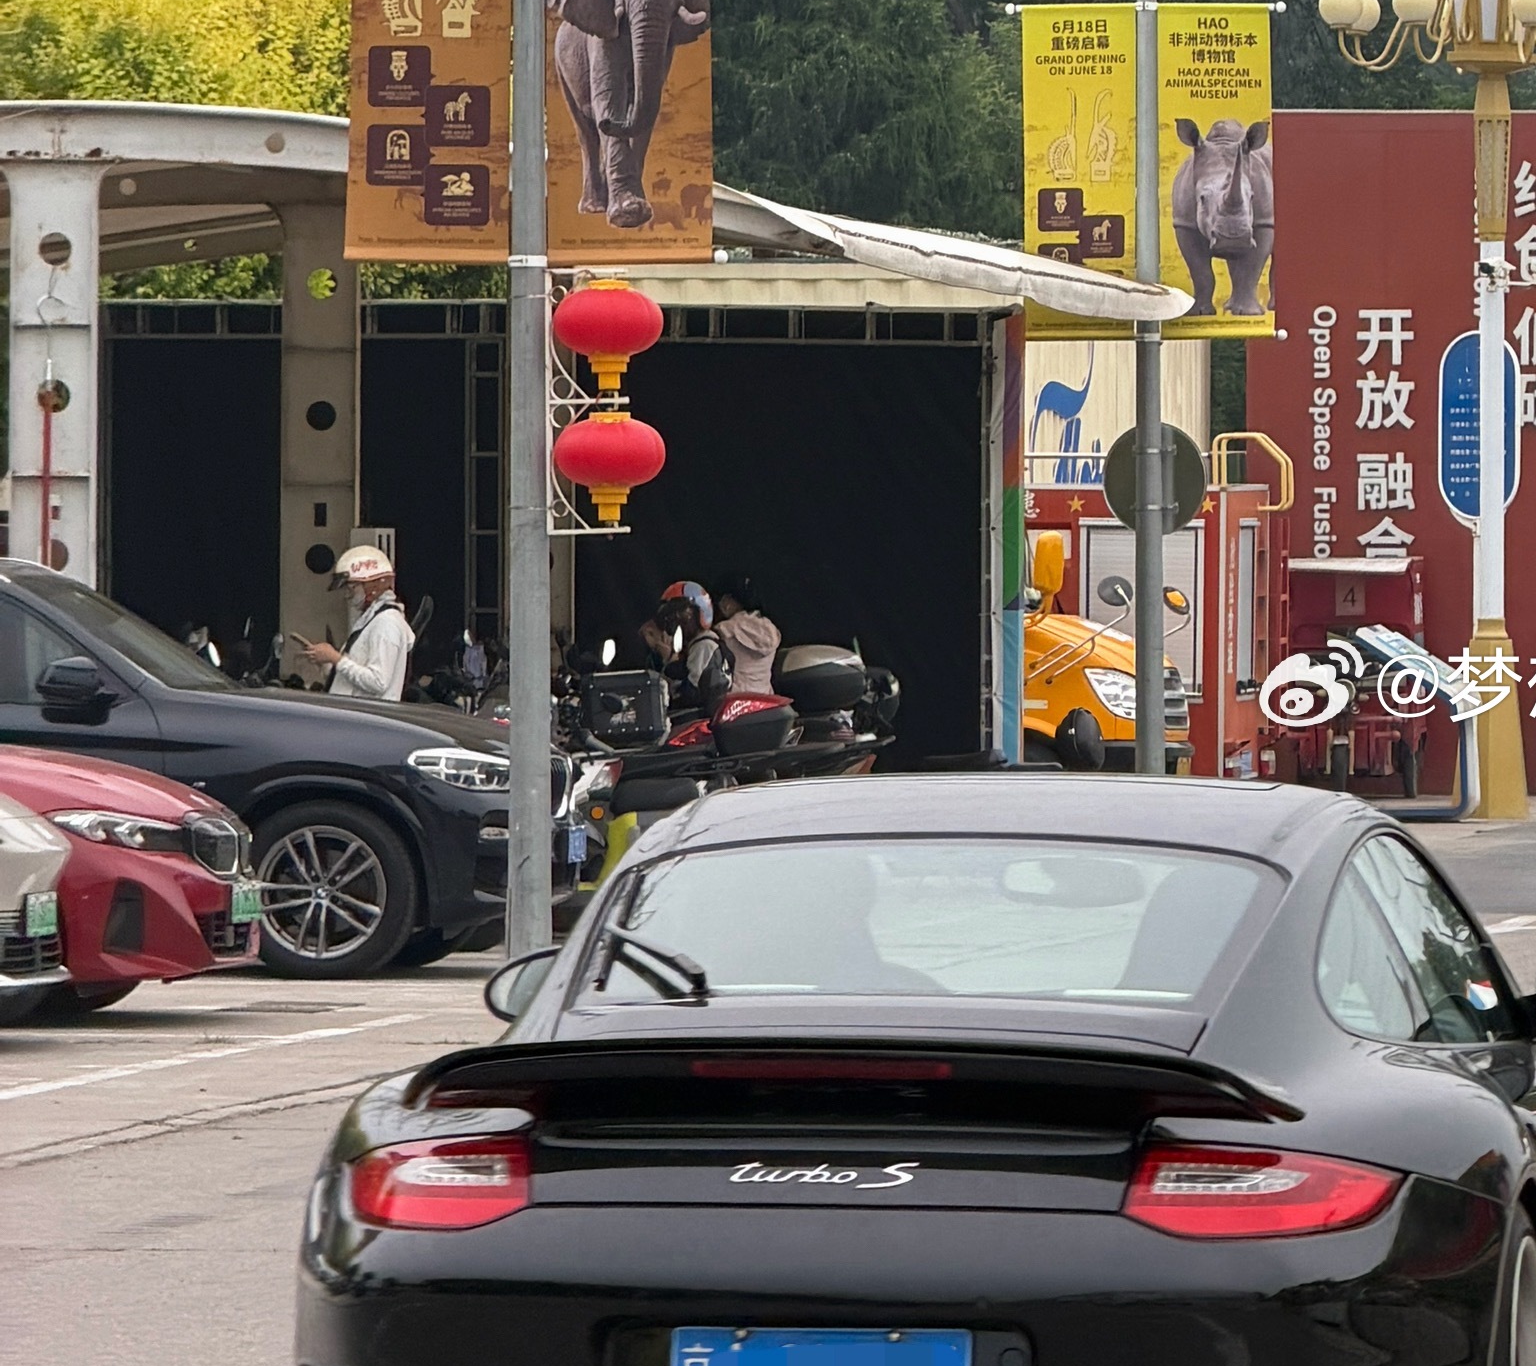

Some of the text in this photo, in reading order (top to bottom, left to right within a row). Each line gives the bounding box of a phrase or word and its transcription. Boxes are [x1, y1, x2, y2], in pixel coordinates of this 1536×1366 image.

[1052, 19, 1107, 34] 6月18日
[1197, 17, 1229, 30] HAO
[1051, 35, 1110, 51] 重磅启幕
[1168, 32, 1258, 47] 非洲动物标本
[1035, 54, 1126, 65] GRAND OPENING
[1191, 48, 1236, 64] 博物馆
[1049, 65, 1113, 76] ON JUNE 18
[1178, 68, 1250, 77] HAO AFRICAN
[1165, 78, 1262, 88] ANIMALSPECIMEN
[1190, 89, 1239, 99] MUSEUM
[1308, 305, 1337, 559] Open Space Fusio
[1355, 309, 1416, 559] 开放 融合
[1342, 586, 1357, 608] 4
[728, 1161, 920, 1189] turbo S
